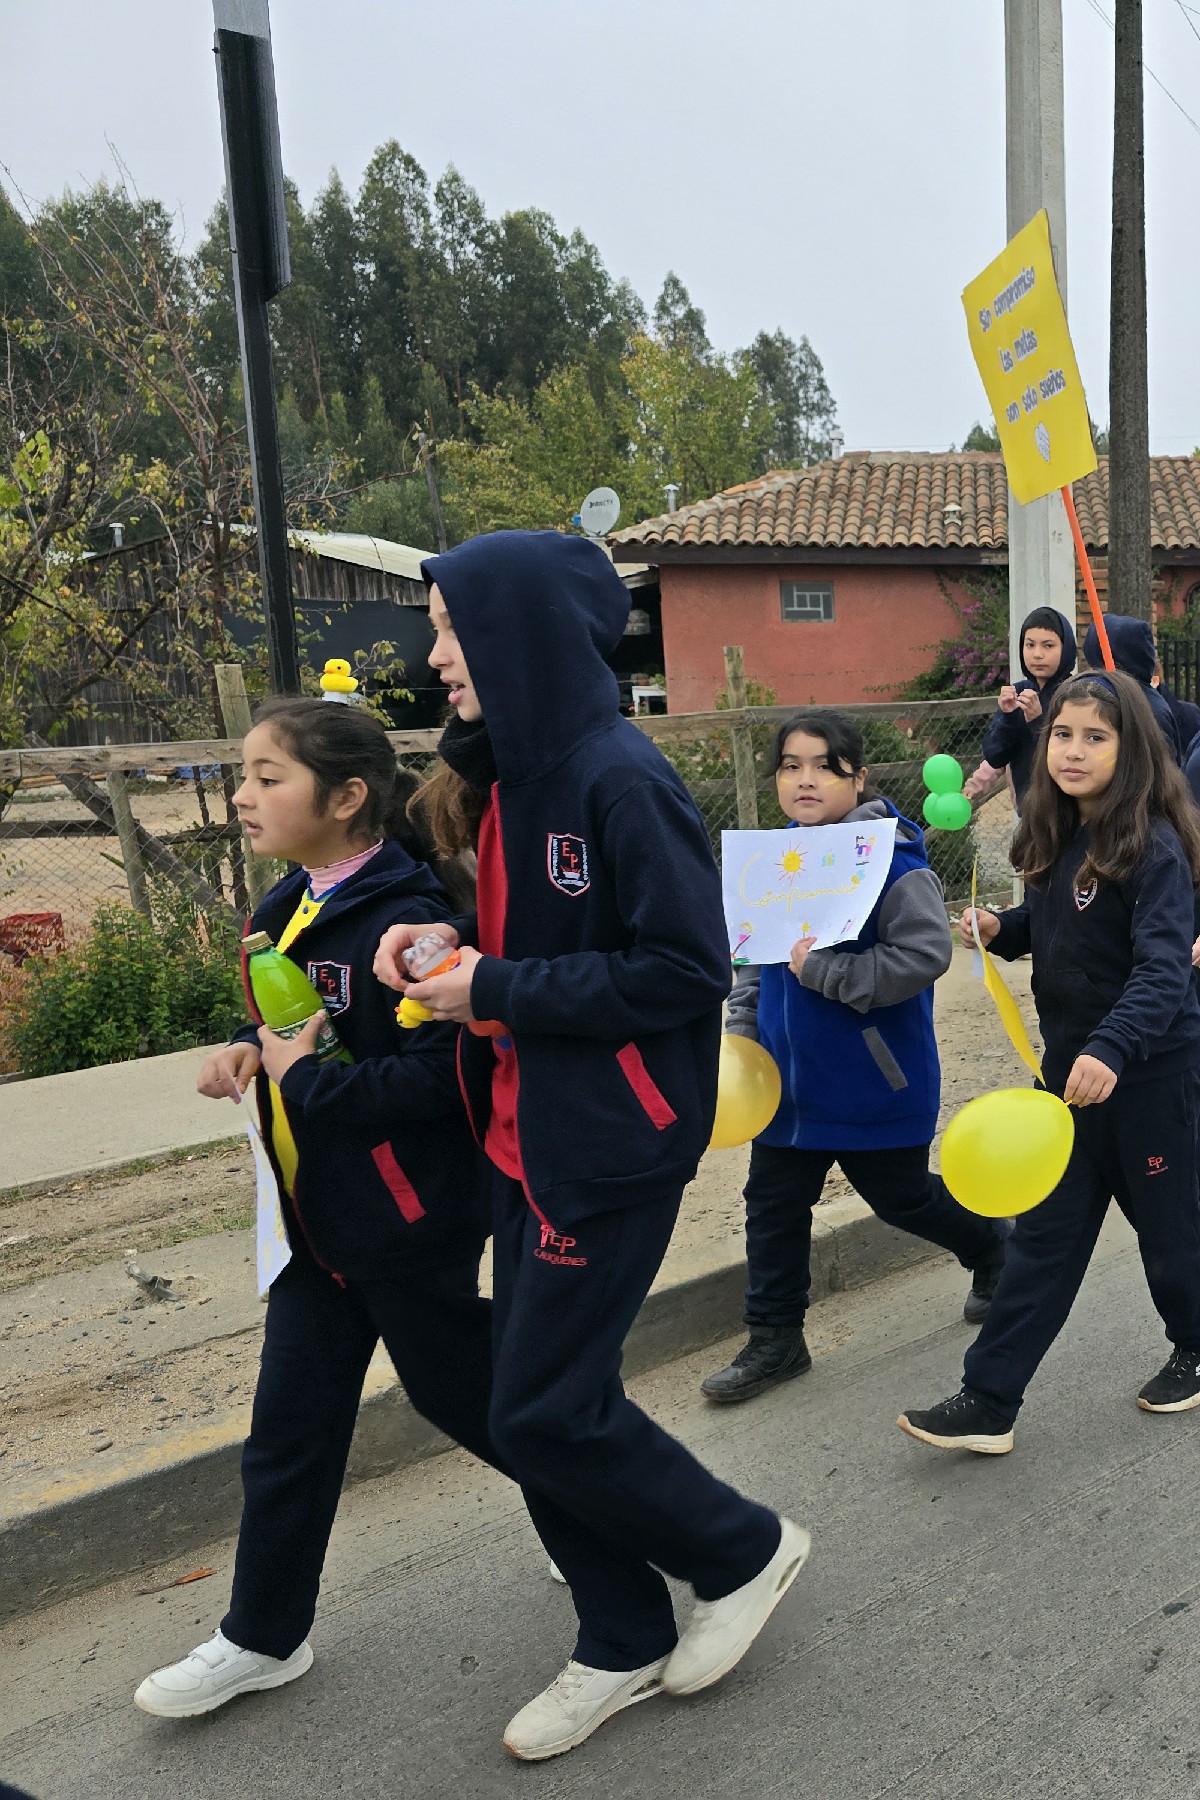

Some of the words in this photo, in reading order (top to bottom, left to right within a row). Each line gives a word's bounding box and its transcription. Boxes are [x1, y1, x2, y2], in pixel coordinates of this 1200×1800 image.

[979, 308, 993, 333] Sin
[994, 266, 1035, 317] compromiso
[1040, 369, 1065, 398] sueños
[562, 842, 578, 869] EP
[320, 968, 336, 993] EP
[1148, 1157, 1163, 1168] EP
